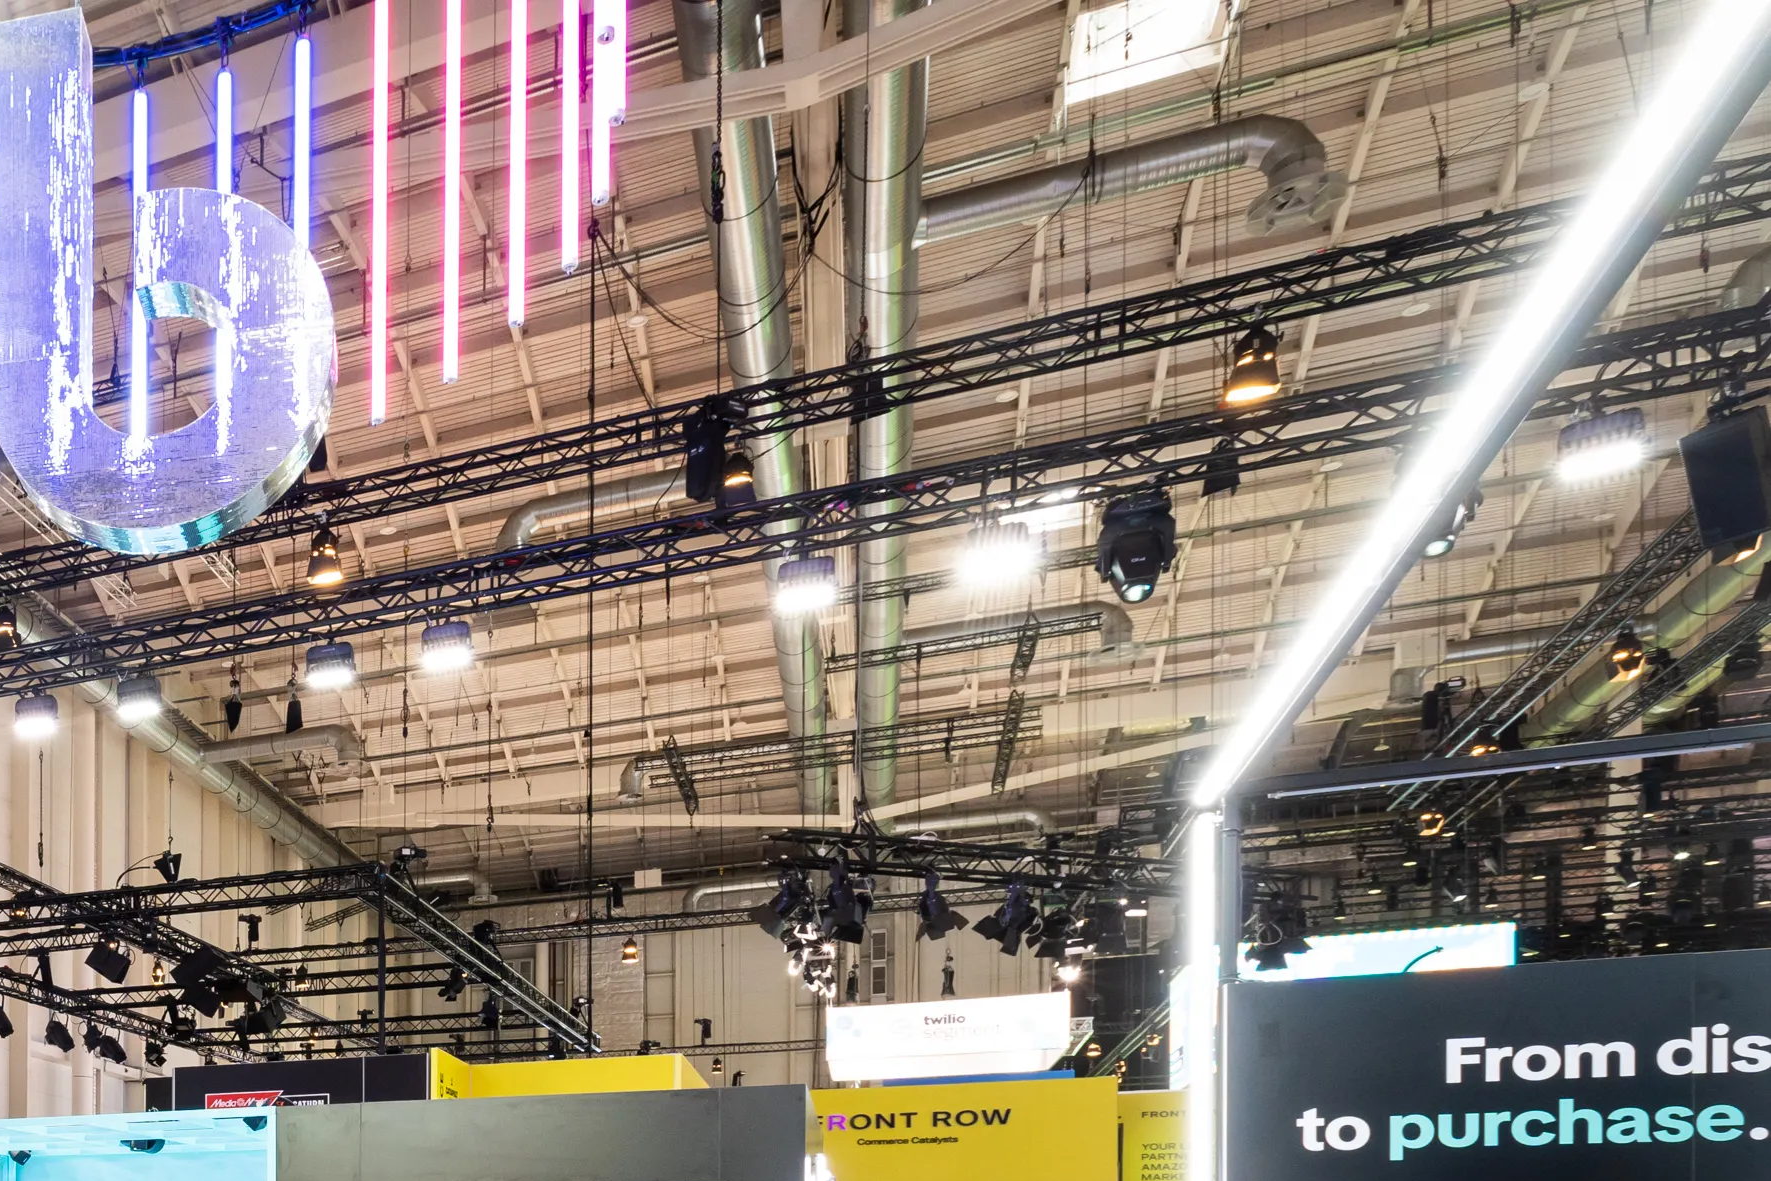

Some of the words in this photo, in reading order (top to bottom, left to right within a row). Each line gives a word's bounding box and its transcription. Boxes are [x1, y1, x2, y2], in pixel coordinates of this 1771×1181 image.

[923, 1013, 966, 1026] twilio
[1445, 1036, 1636, 1084] From
[1656, 1023, 1771, 1076] dis
[816, 1112, 918, 1131] RONT
[931, 1108, 1012, 1128] ROW
[1296, 1107, 1371, 1151] to
[1389, 1098, 1770, 1161] purchase.
[857, 1138, 909, 1146] Commerce
[911, 1136, 959, 1145] Catalysts
[1142, 1143, 1176, 1151] YOUR
